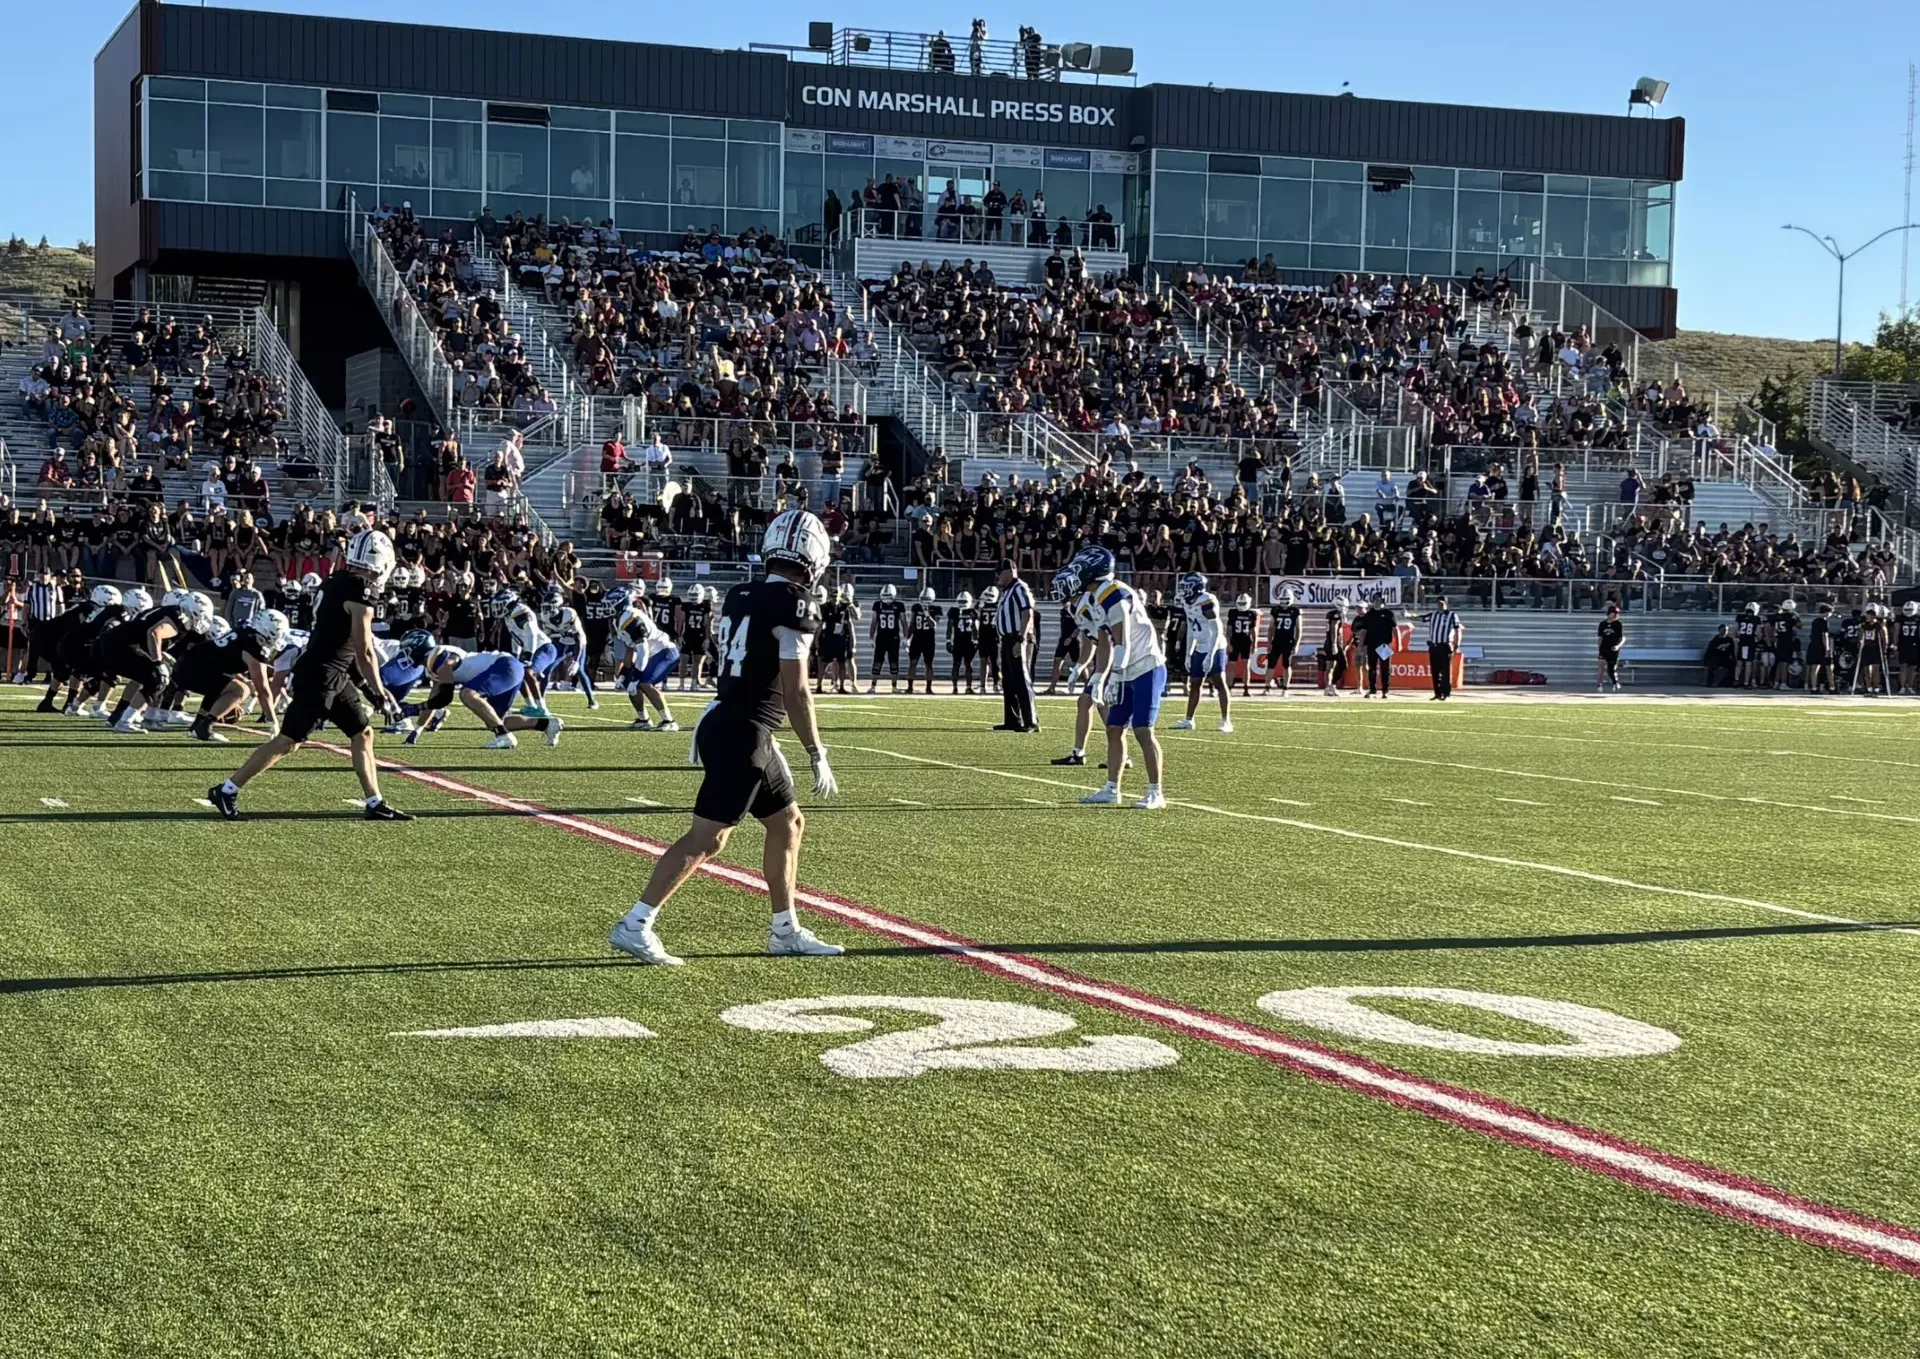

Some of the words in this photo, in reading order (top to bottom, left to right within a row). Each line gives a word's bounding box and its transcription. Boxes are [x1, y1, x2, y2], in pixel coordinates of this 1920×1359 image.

[802, 85, 851, 107] CON
[858, 90, 985, 118] MARSHALL
[991, 100, 1063, 123] PRESS
[1069, 106, 1116, 127] BOX
[1308, 582, 1351, 603] Student
[1356, 580, 1397, 603] Section
[654, 609, 671, 624] 76
[880, 614, 895, 629] 68
[1276, 617, 1292, 630] 79
[1740, 622, 1753, 635] 28
